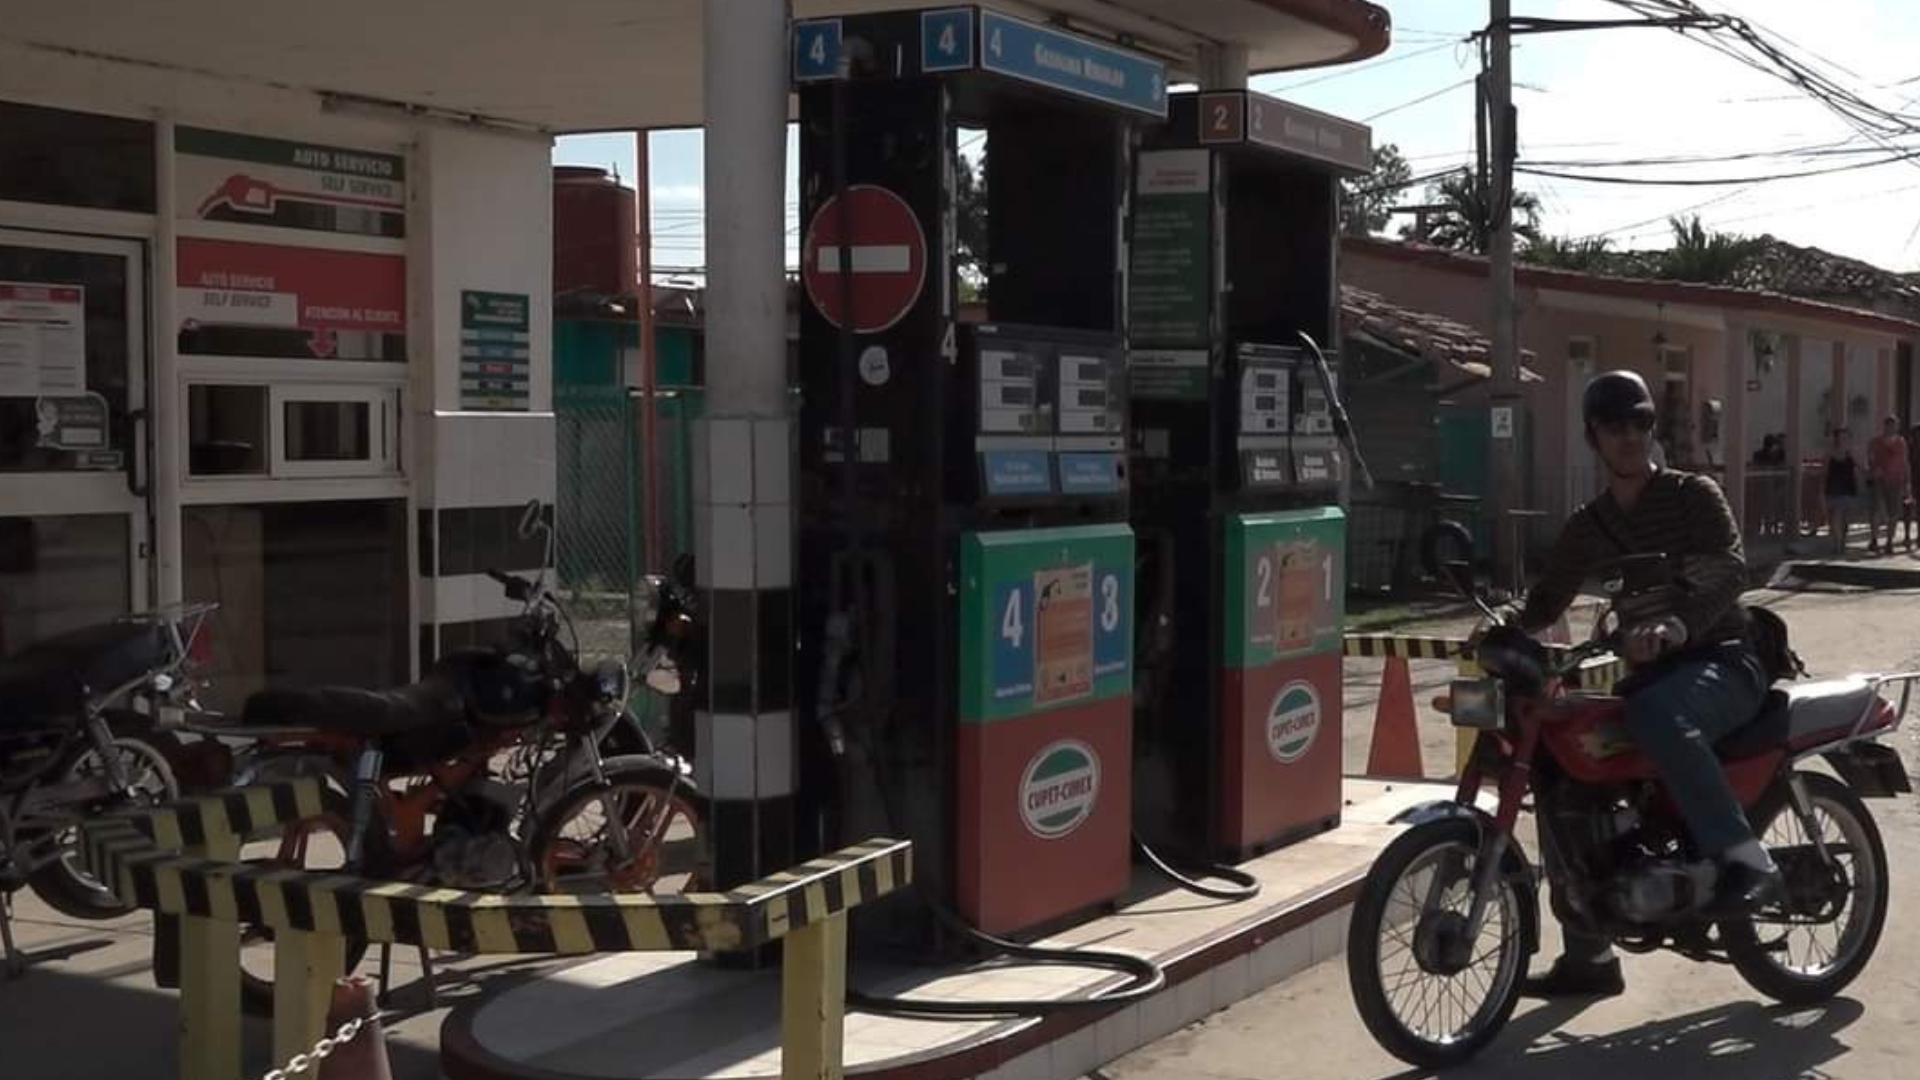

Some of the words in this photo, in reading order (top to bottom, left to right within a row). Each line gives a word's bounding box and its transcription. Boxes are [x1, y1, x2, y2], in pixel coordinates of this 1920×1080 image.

[809, 33, 826, 66] 4
[939, 24, 955, 56] 4
[990, 28, 1002, 58] 4
[1213, 104, 1228, 131] 2
[293, 148, 329, 168] AUTO
[334, 151, 394, 176] SERVICIO
[321, 174, 346, 191] SELF
[349, 178, 393, 197] SERVICE
[202, 271, 228, 287] AUTO
[940, 321, 958, 365] 4
[1256, 555, 1272, 608] 2
[1322, 552, 1333, 602] 1
[1002, 587, 1024, 649] 4
[1100, 573, 1120, 633] 3
[1027, 775, 1093, 811] CUPET-CIMEX
